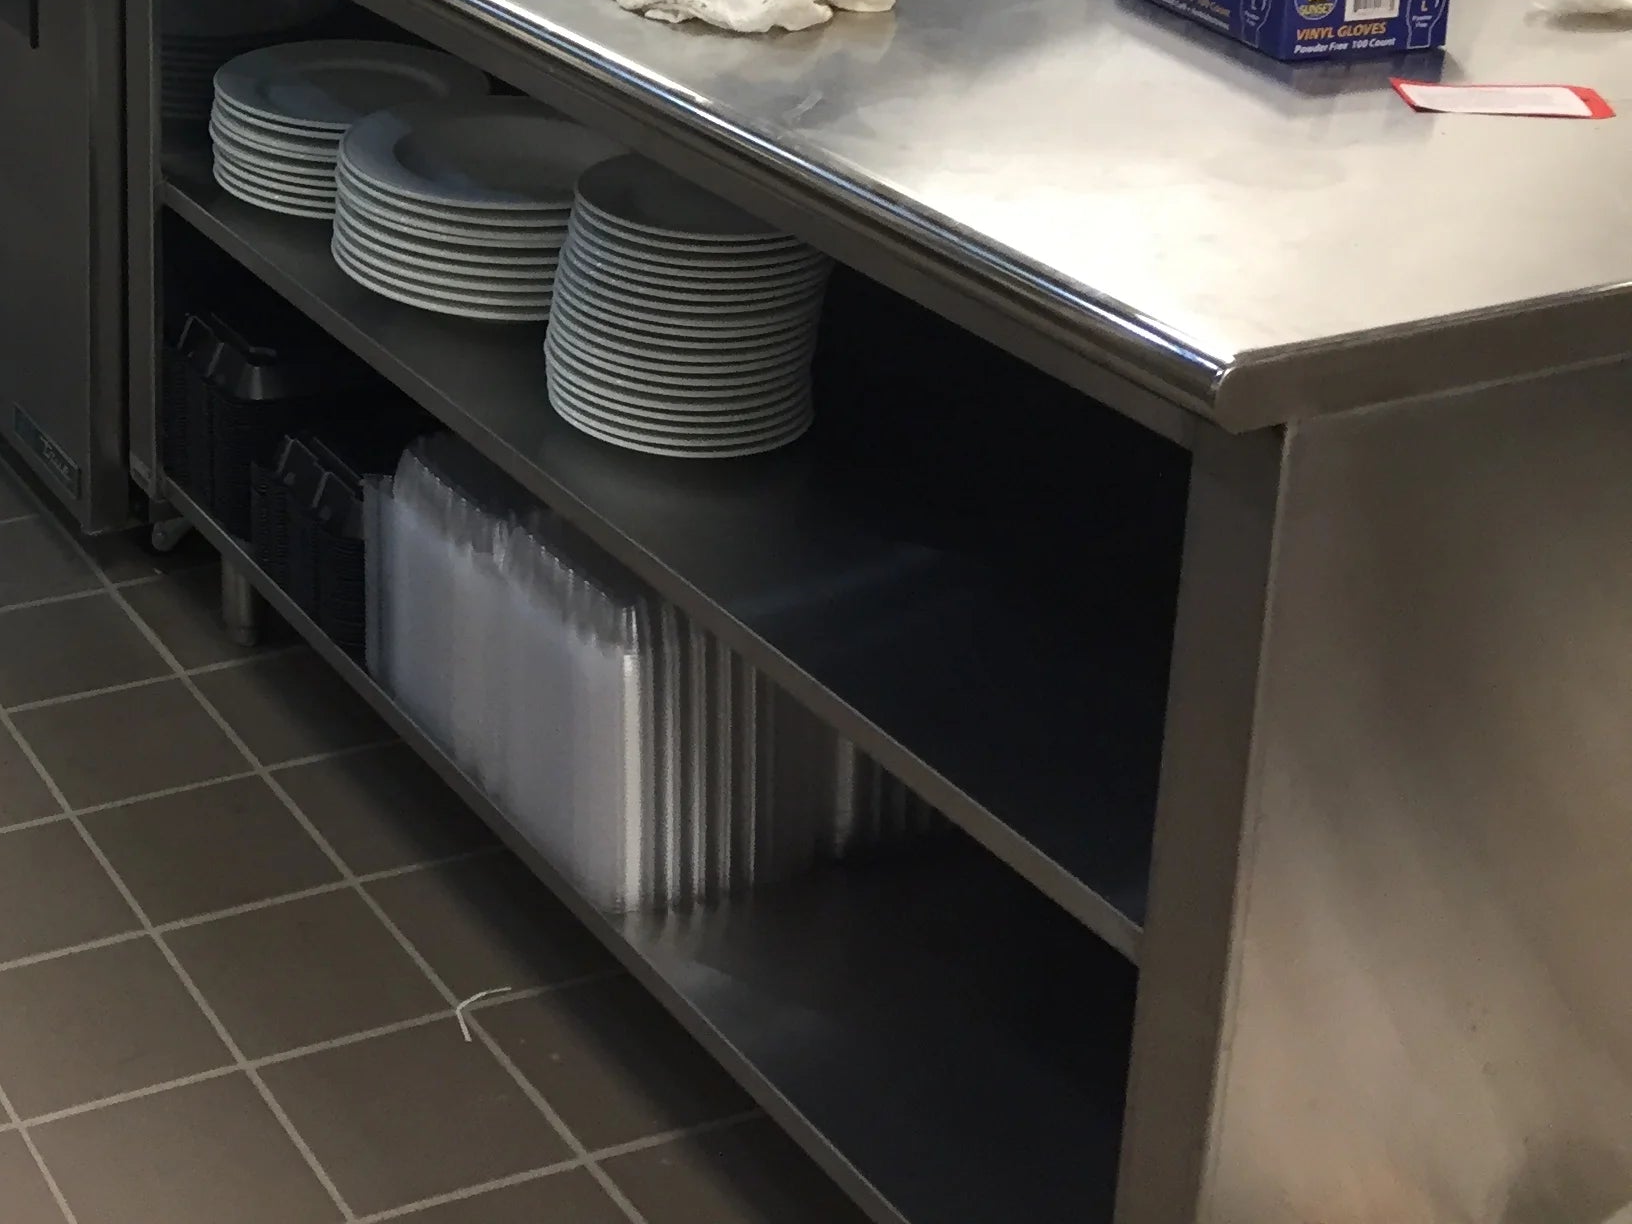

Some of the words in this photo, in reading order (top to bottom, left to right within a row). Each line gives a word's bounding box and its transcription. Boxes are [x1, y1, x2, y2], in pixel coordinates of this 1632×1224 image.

[1298, 3, 1334, 16] SUNSET
[1420, 0, 1428, 12] L
[1296, 26, 1334, 41] VINYL
[1336, 22, 1387, 38] GLOVES
[1293, 42, 1328, 55] Powder
[1328, 42, 1349, 51] Free
[1351, 39, 1368, 50] 100
[1368, 37, 1396, 48] Count
